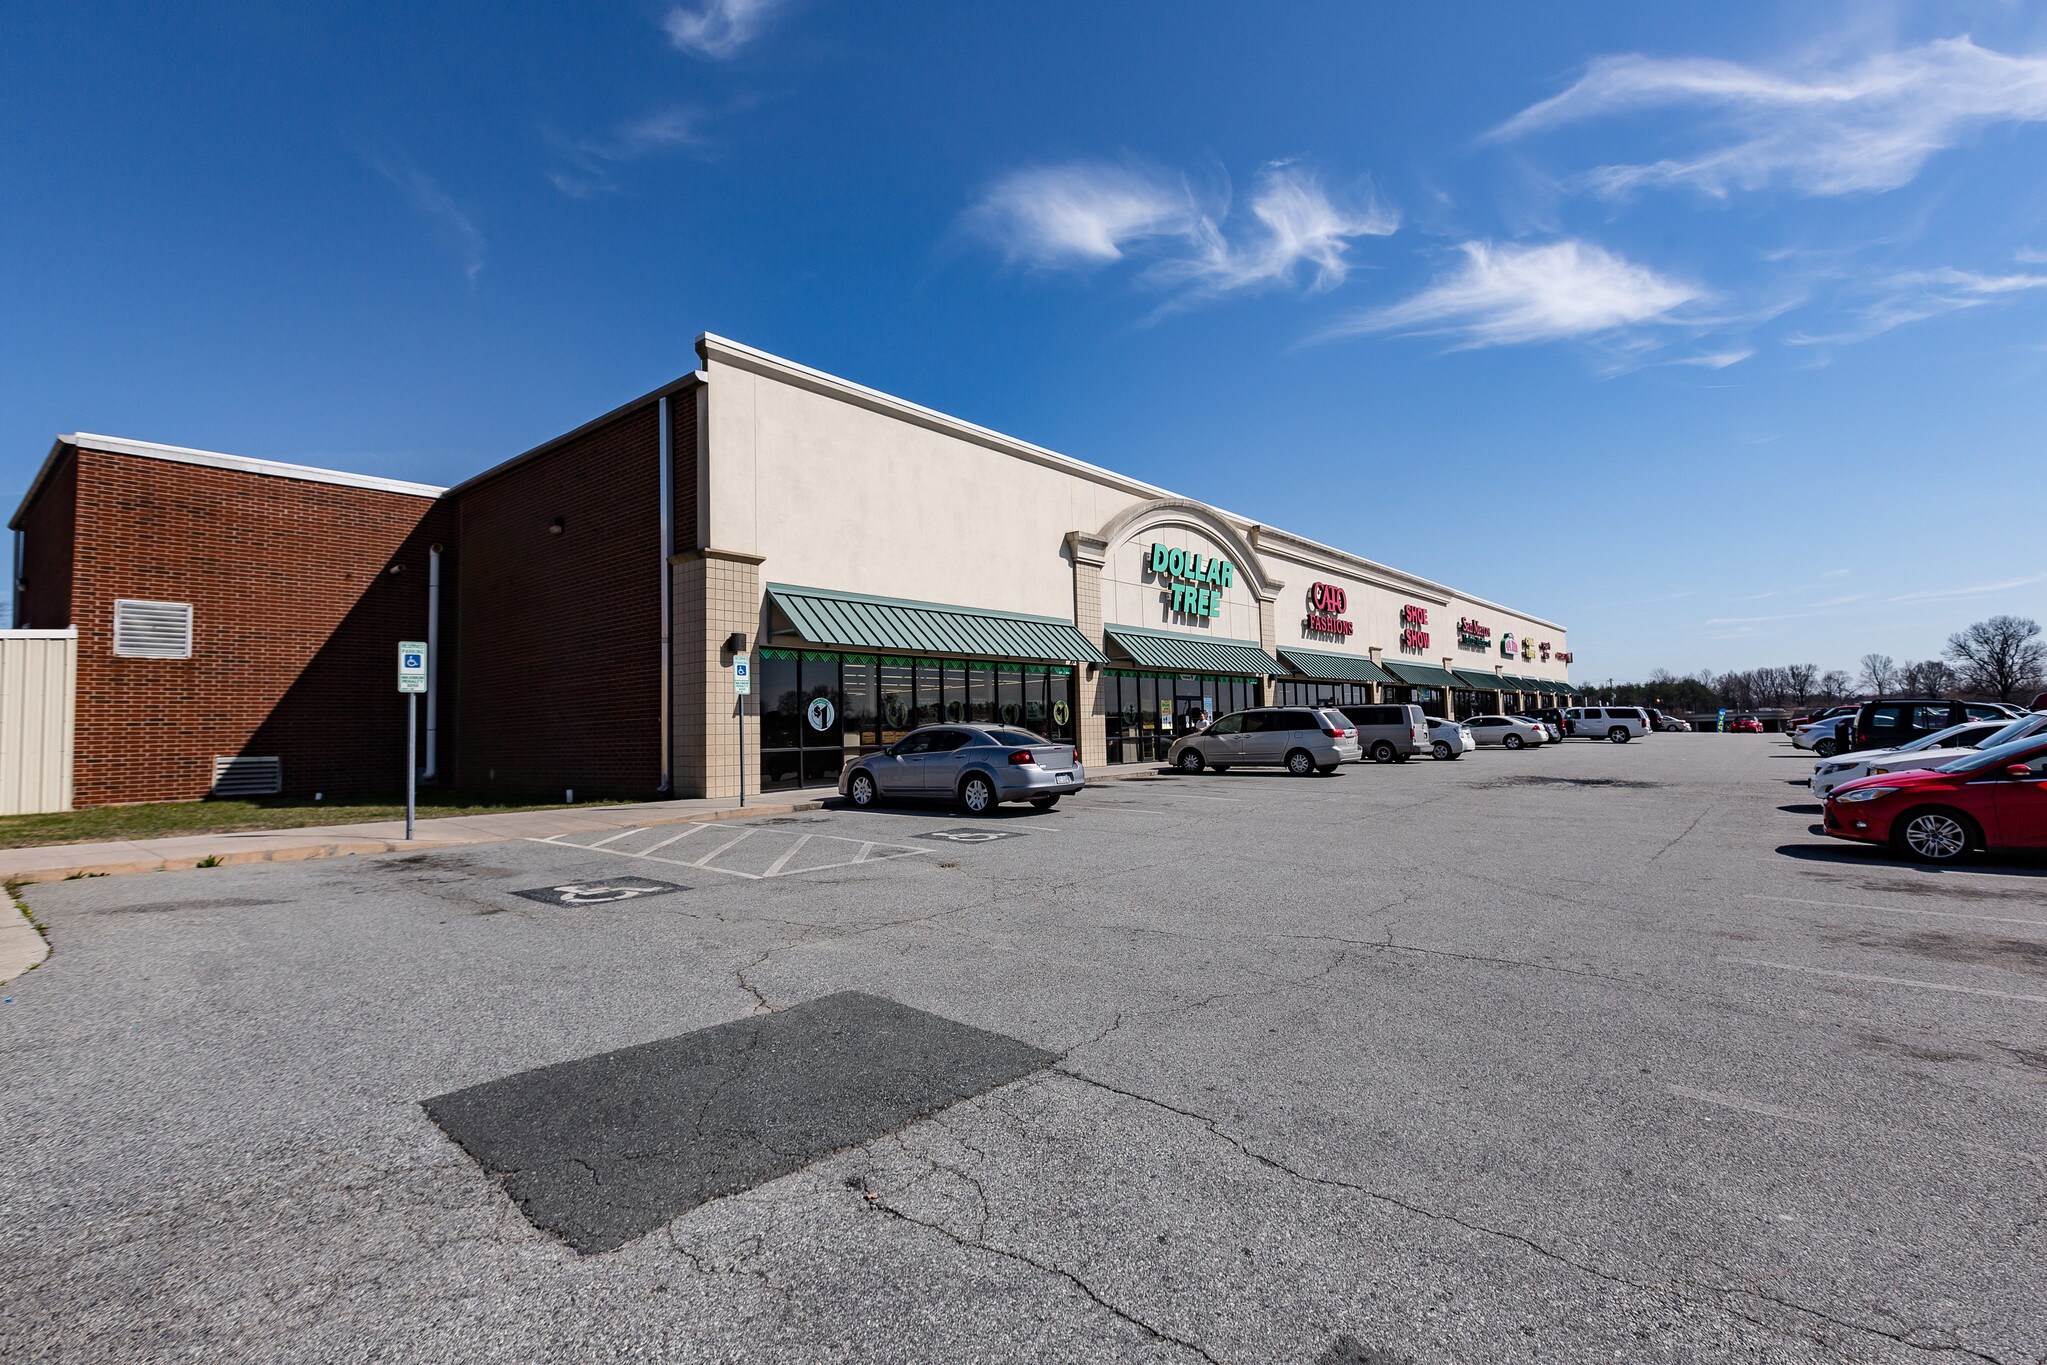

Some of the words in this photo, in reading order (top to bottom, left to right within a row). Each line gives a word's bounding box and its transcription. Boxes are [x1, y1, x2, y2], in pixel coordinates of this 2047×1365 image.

[1152, 543, 1234, 588] DOLLAR
[1171, 582, 1222, 618] TREE
[1312, 581, 1347, 614] CATO
[1308, 613, 1353, 636] FASHIONS
[1405, 604, 1429, 625] SHOE
[1404, 628, 1430, 649] SHOW
[813, 704, 828, 729] $1
